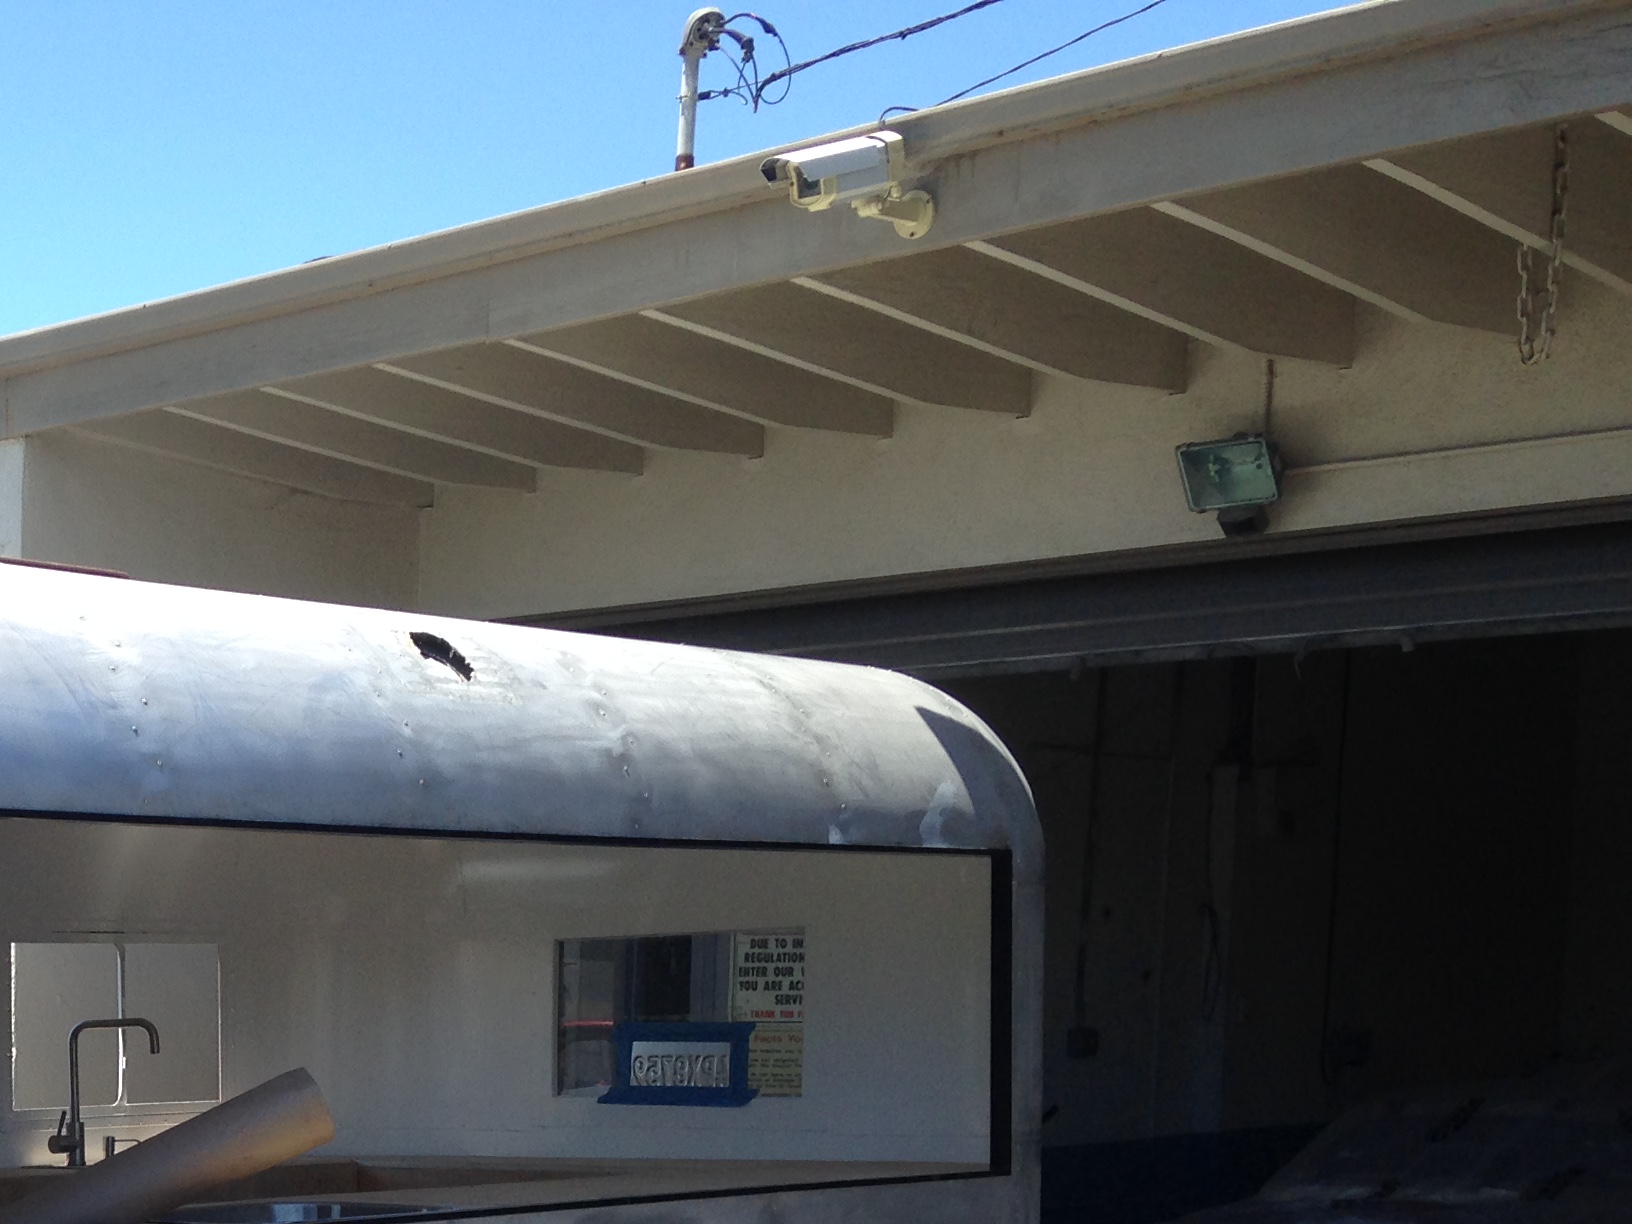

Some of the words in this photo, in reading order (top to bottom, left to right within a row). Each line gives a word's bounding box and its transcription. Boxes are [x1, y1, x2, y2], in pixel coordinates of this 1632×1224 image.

[750, 938, 769, 949] DUE
[774, 938, 788, 949] TO
[739, 966, 768, 977] ENTER
[773, 966, 794, 977] OUR
[739, 981, 758, 991] YOU
[763, 981, 783, 991] ARE
